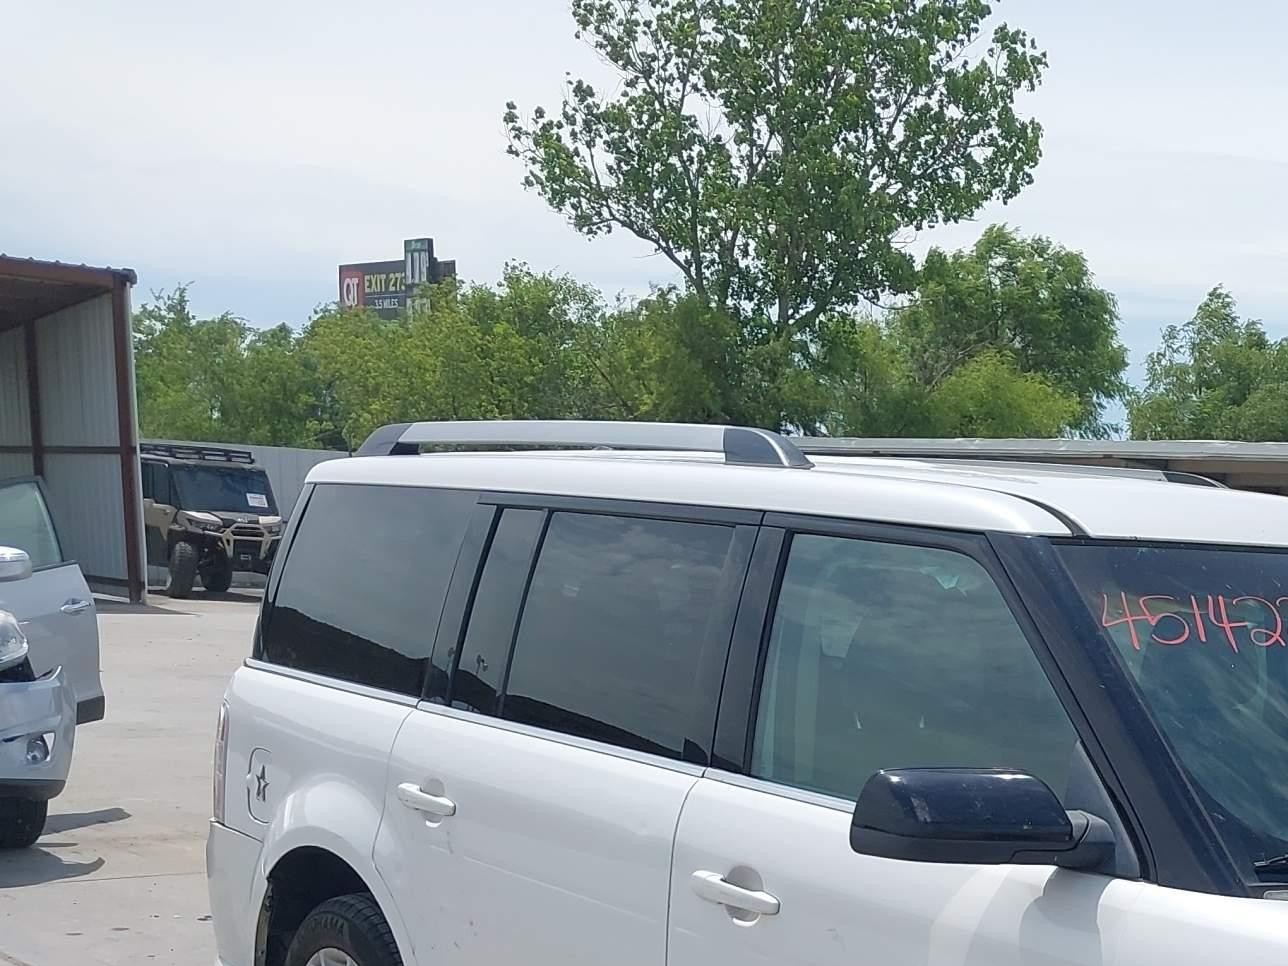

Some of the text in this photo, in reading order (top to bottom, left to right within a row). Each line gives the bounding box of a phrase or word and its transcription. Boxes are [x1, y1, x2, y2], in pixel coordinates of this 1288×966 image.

[343, 277, 360, 307] QT
[364, 273, 386, 293] EXIT
[383, 298, 399, 309] MILES
